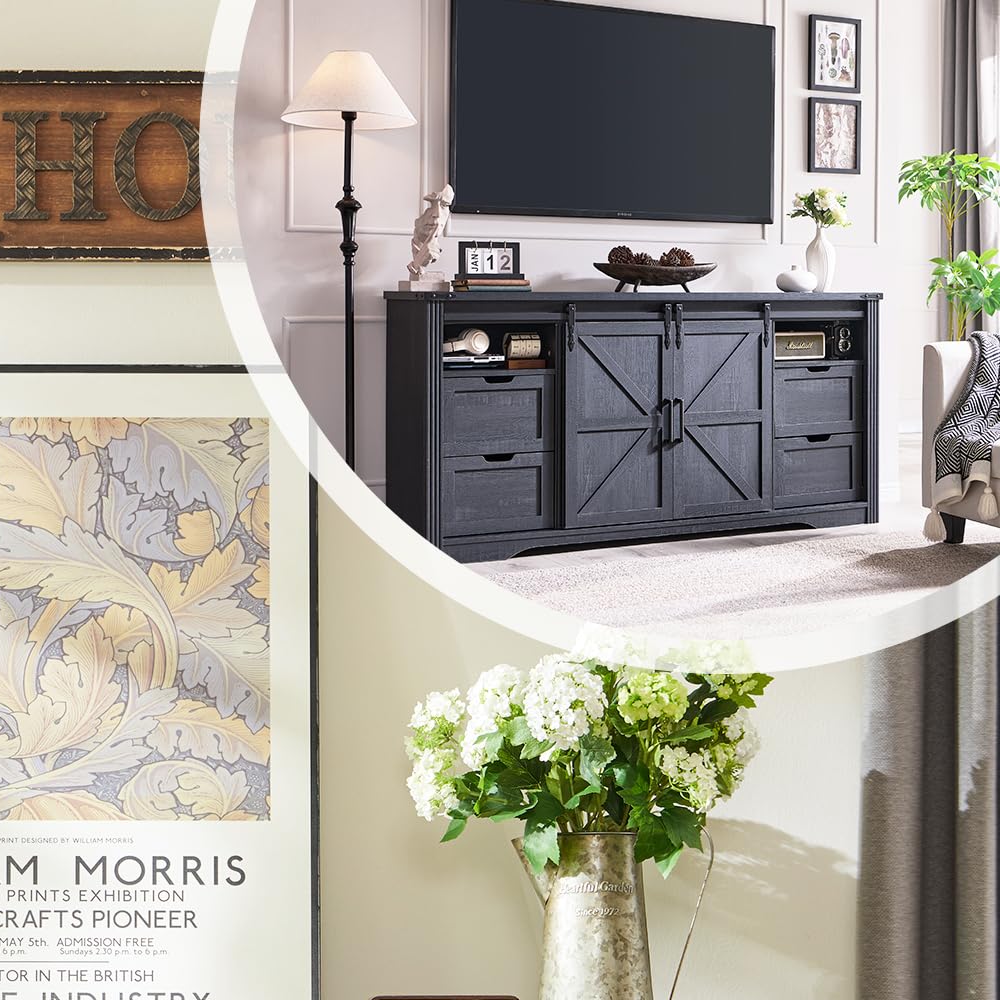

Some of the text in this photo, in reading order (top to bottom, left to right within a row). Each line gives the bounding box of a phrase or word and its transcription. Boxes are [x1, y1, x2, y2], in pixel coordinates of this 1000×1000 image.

[2, 110, 206, 222] HO
[471, 253, 479, 272] JAN
[74, 855, 247, 886] MORRIS
[7, 889, 71, 902] PRINTS
[79, 889, 184, 902] EXHIBITION
[92, 909, 198, 928] PIONEER
[28, 937, 49, 947] 5th.
[56, 937, 122, 947] ADMISSION
[126, 937, 154, 947] FREE
[60, 948, 93, 957] Sundays
[35, 970, 50, 982] IN
[56, 970, 89, 982] THE
[94, 970, 154, 982] BRITISH
